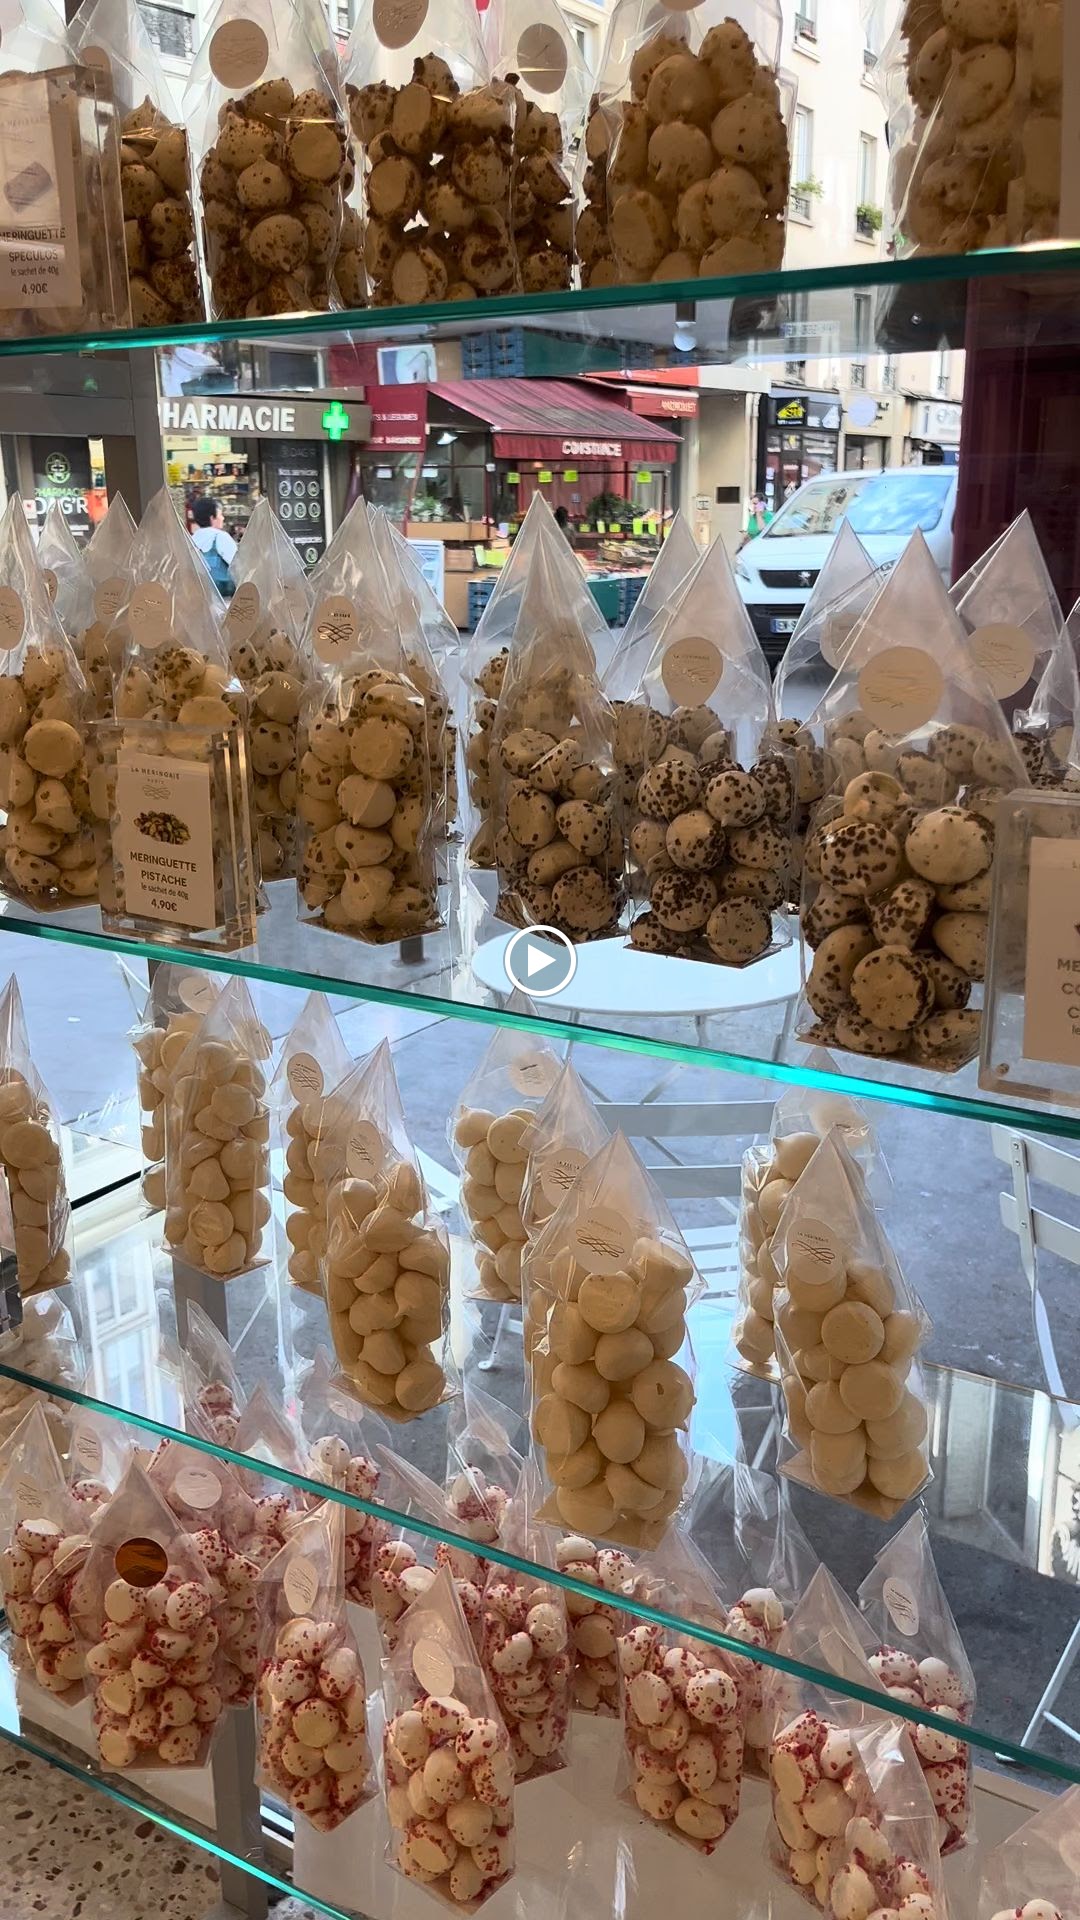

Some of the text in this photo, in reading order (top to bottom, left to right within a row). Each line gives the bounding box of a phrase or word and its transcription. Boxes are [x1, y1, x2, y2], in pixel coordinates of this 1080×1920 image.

[38, 265, 47, 275] de
[48, 265, 59, 276] 40g
[157, 402, 296, 431] HARMACIE
[130, 851, 197, 873] MERINGUETTE
[141, 870, 187, 887] PISTACHE
[141, 882, 189, 901] le sachet de 40g
